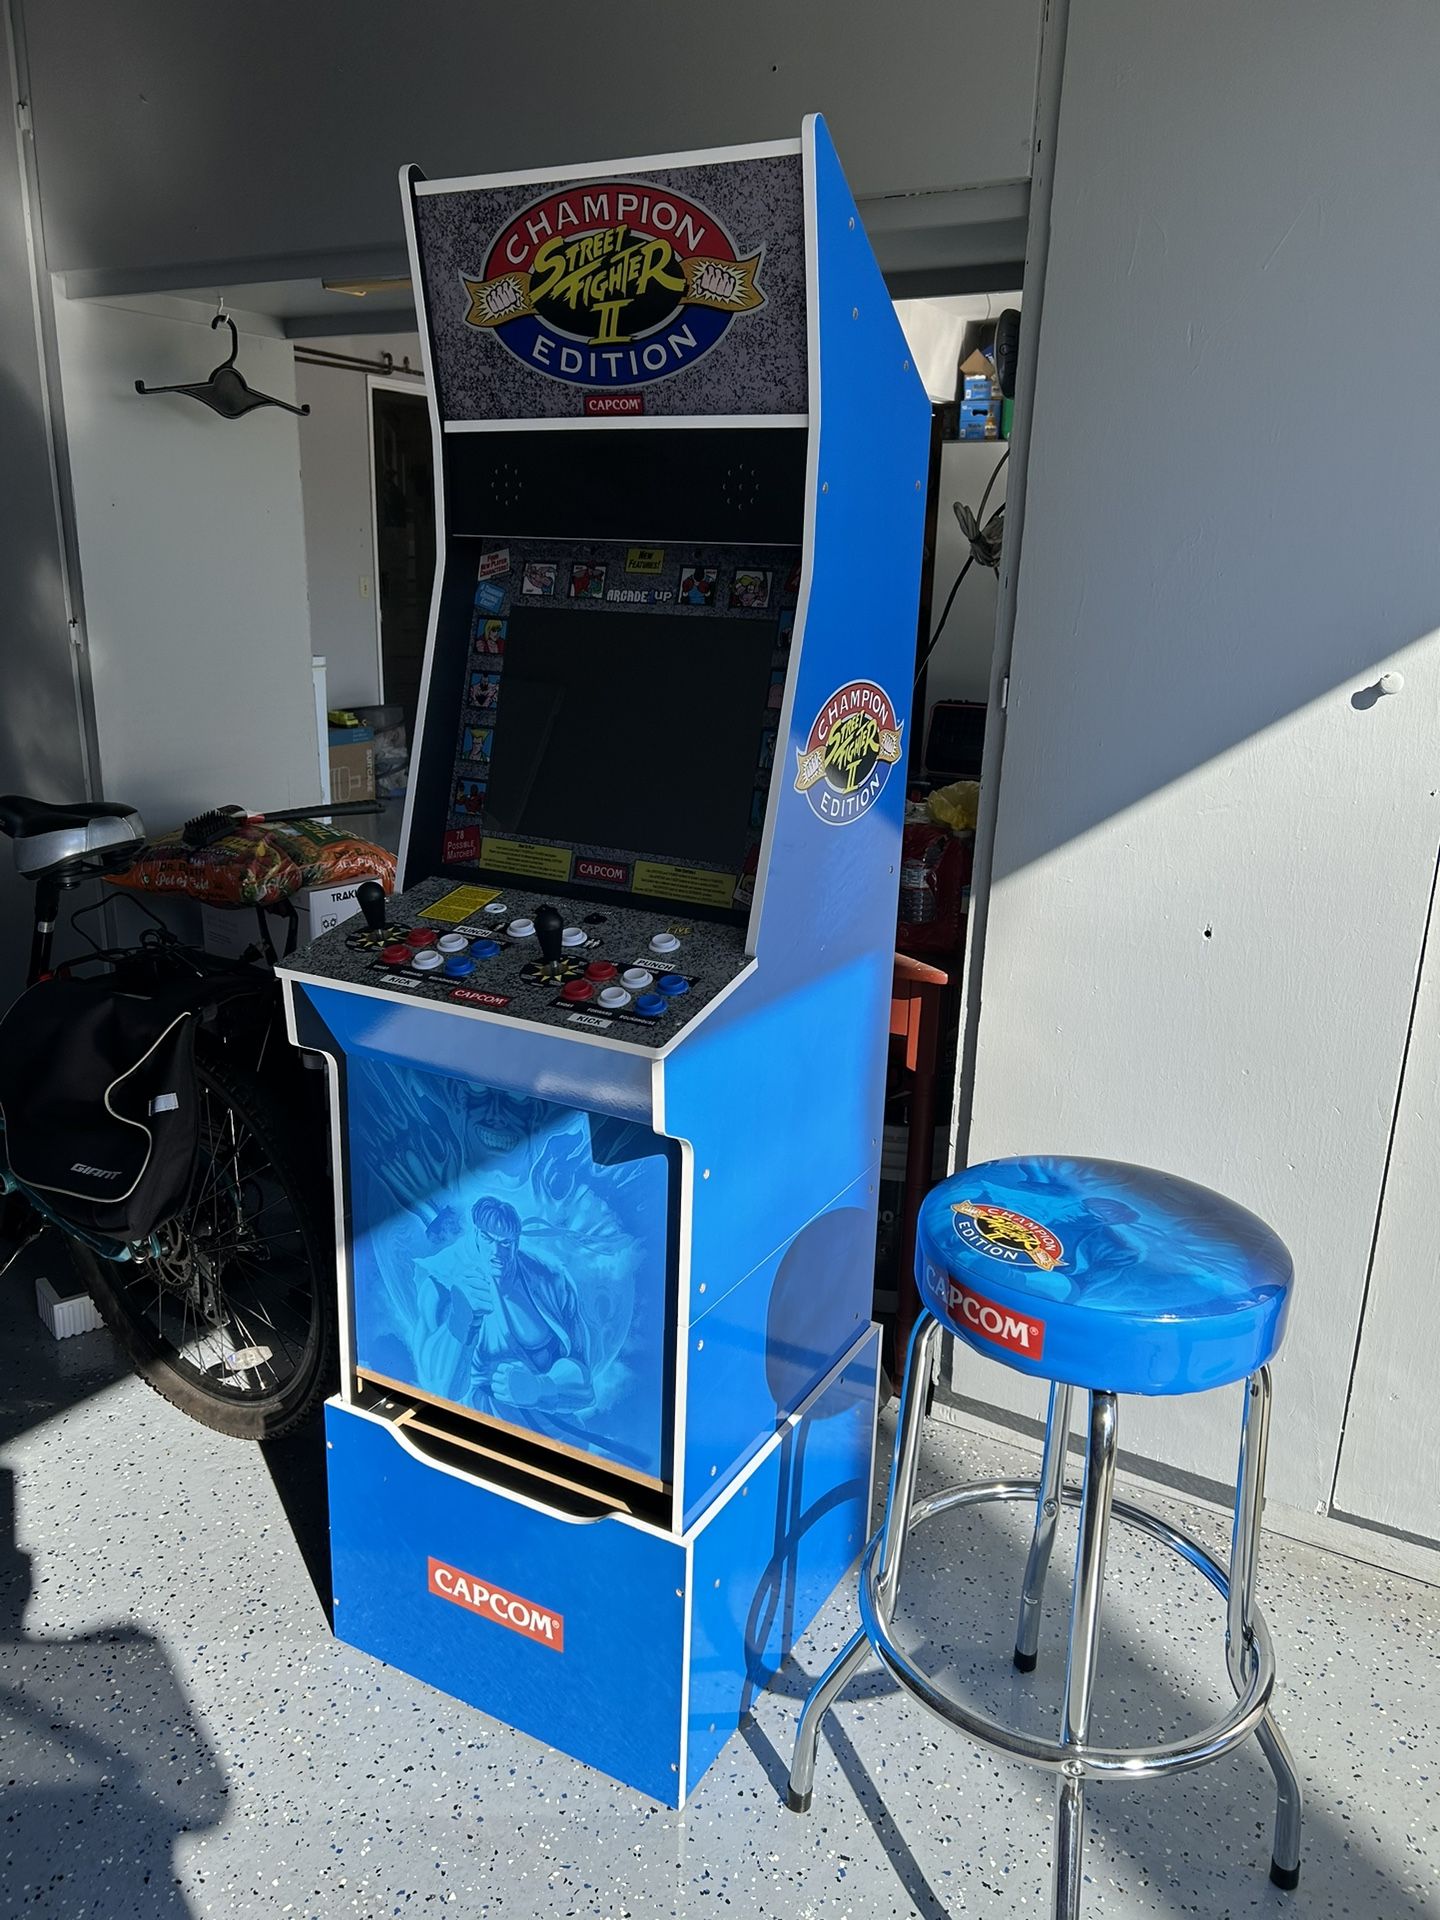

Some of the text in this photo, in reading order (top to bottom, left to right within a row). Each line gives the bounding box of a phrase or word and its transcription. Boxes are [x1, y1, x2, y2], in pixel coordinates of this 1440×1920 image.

[505, 193, 706, 265] CHAMPION
[530, 225, 628, 305] STREET
[556, 239, 687, 310] FIGHTER
[532, 323, 698, 379] EDITION
[589, 398, 640, 412] CAPCOM
[818, 689, 889, 741] CHAMPION
[824, 709, 866, 768] STREET
[820, 773, 880, 817] EDITION
[579, 863, 624, 880] CAPCOM
[458, 926, 489, 936] PUNCH
[388, 976, 413, 985] KICK
[638, 960, 673, 970] PUNCH
[455, 989, 506, 1005] CAPCOM
[577, 1015, 601, 1025] KICK
[70, 1163, 123, 1180] GIANT
[959, 1221, 1018, 1260] EDITION
[988, 1208, 1056, 1252] CHAMPION
